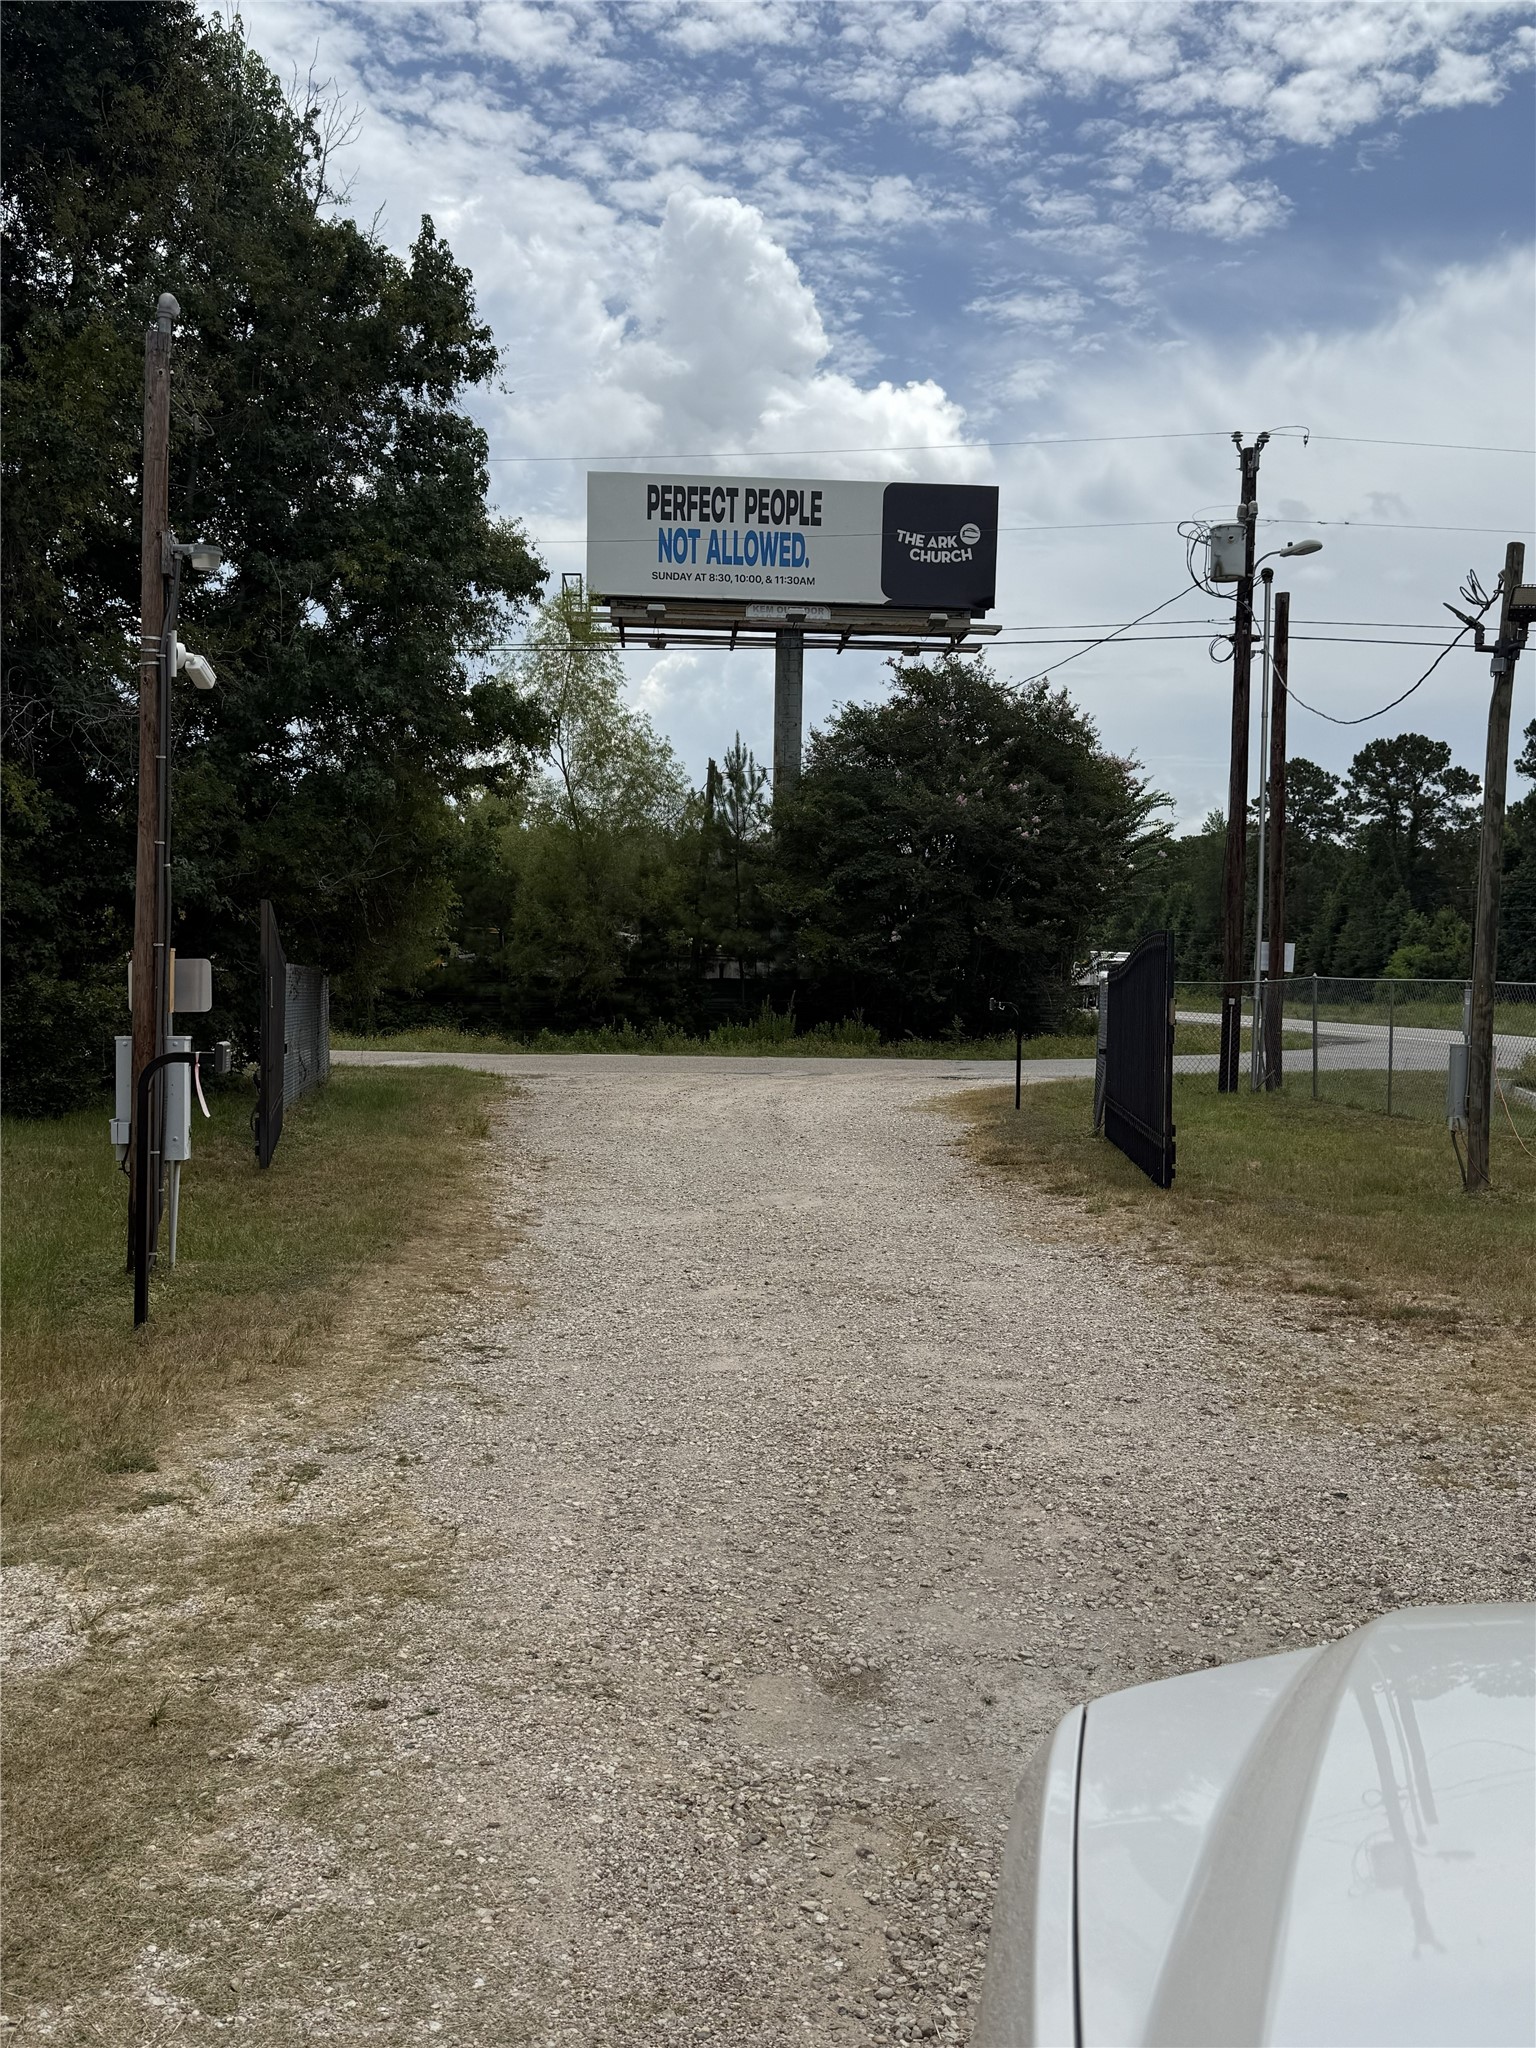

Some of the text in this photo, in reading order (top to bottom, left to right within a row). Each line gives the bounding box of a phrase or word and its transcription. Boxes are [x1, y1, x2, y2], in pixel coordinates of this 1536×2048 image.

[647, 484, 823, 526] PERFECT PEOPLE
[658, 527, 810, 568] NOT ALLOWED.
[896, 529, 958, 549] THE ARK
[909, 547, 973, 563] CHURCH
[651, 571, 816, 585] SUNDAY AT 8:30, 10:00, & 11:30AM
[752, 604, 774, 614] KEM
